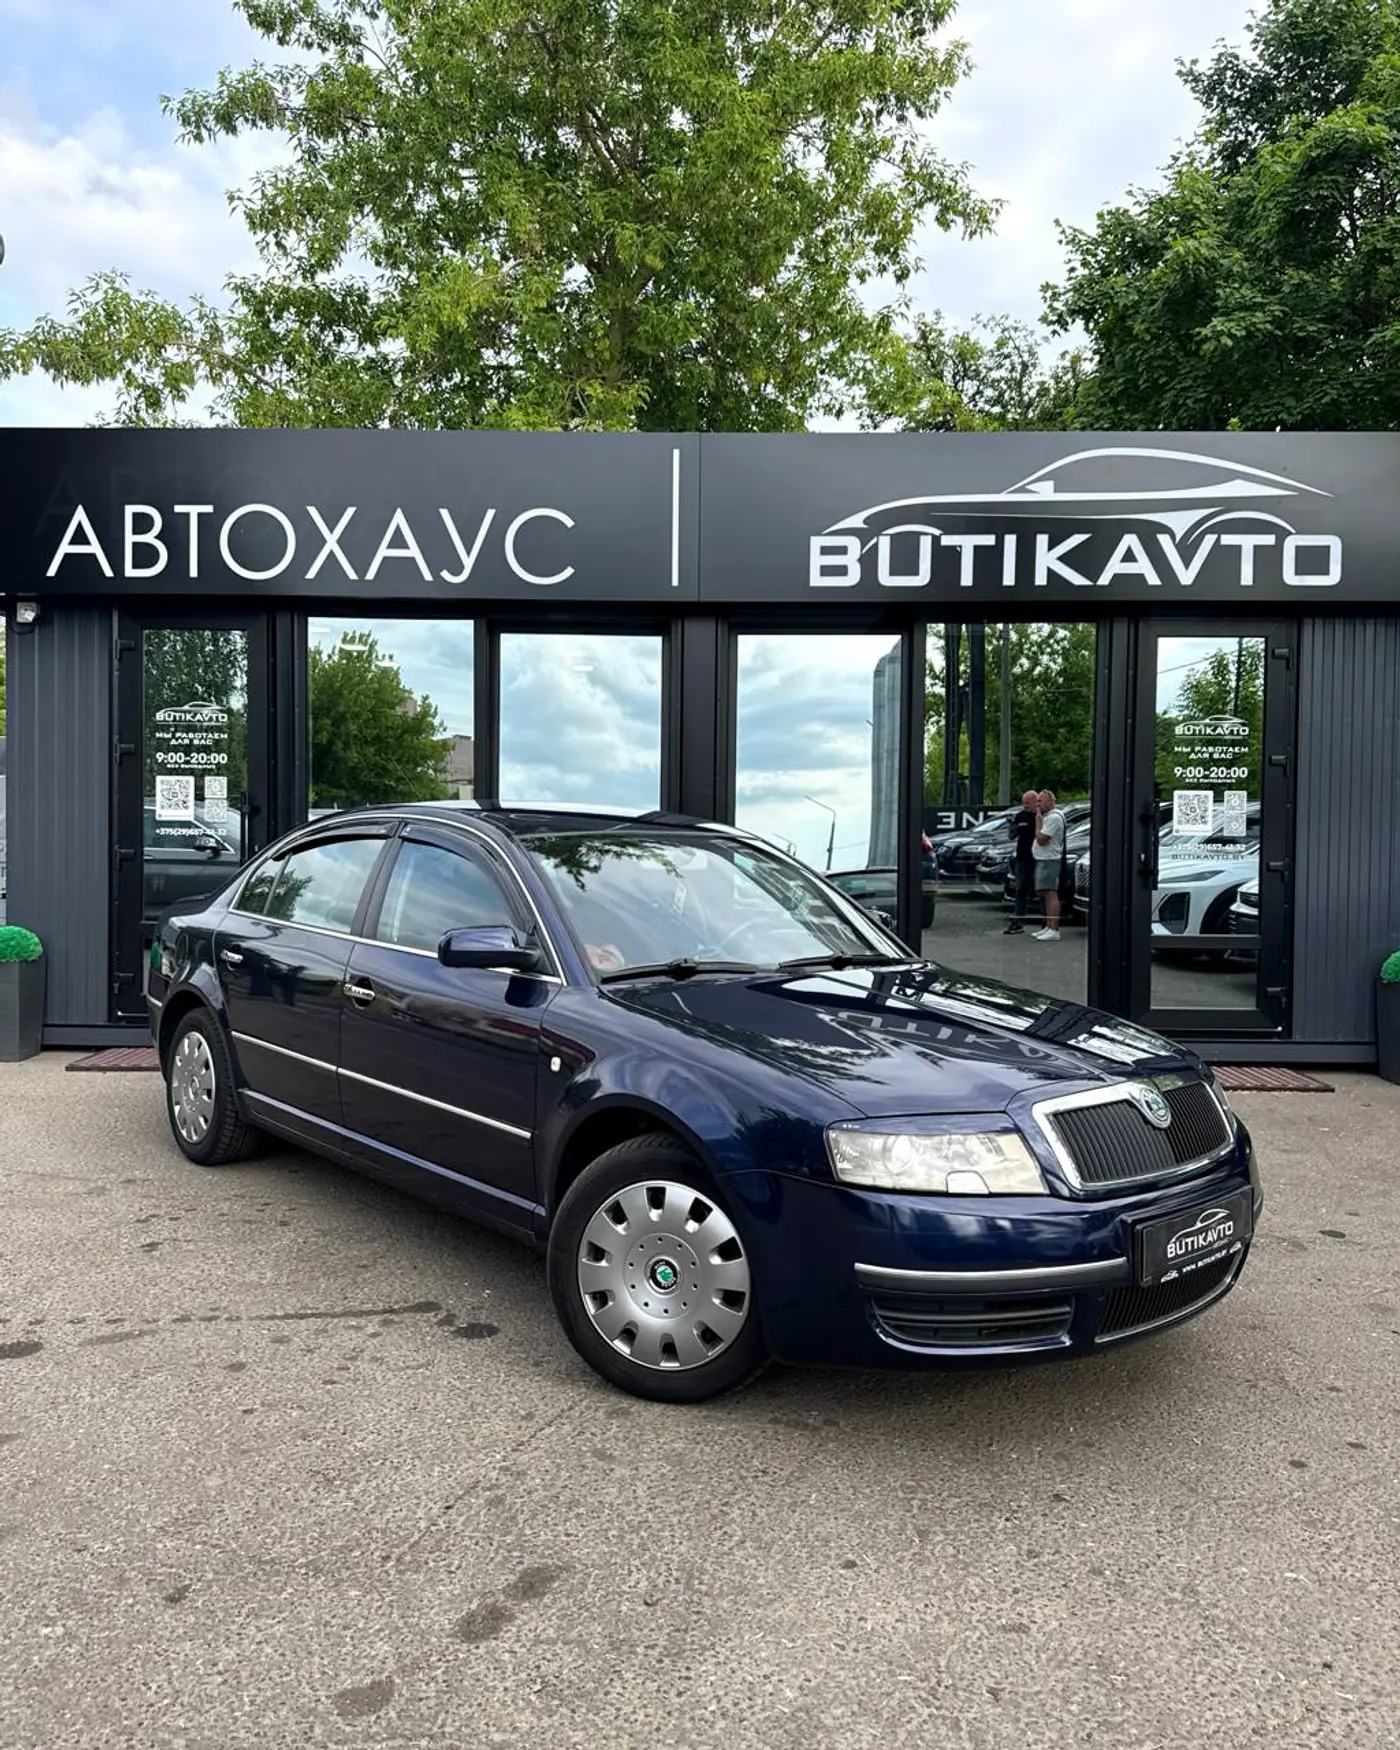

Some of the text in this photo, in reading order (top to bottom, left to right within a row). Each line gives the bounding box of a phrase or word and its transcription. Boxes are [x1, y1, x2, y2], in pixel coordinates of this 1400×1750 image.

[46, 503, 576, 586] АВТОХАУС
[809, 532, 1342, 587] BUTIKAVTO
[156, 712, 228, 722] BUTIKAVTO
[1174, 726, 1249, 735] BUTIKAVTO
[156, 752, 228, 764] 9:00-20:00
[1174, 766, 1248, 777] 9:00-20:00
[1166, 1221, 1234, 1259] BUTIKAVTO
